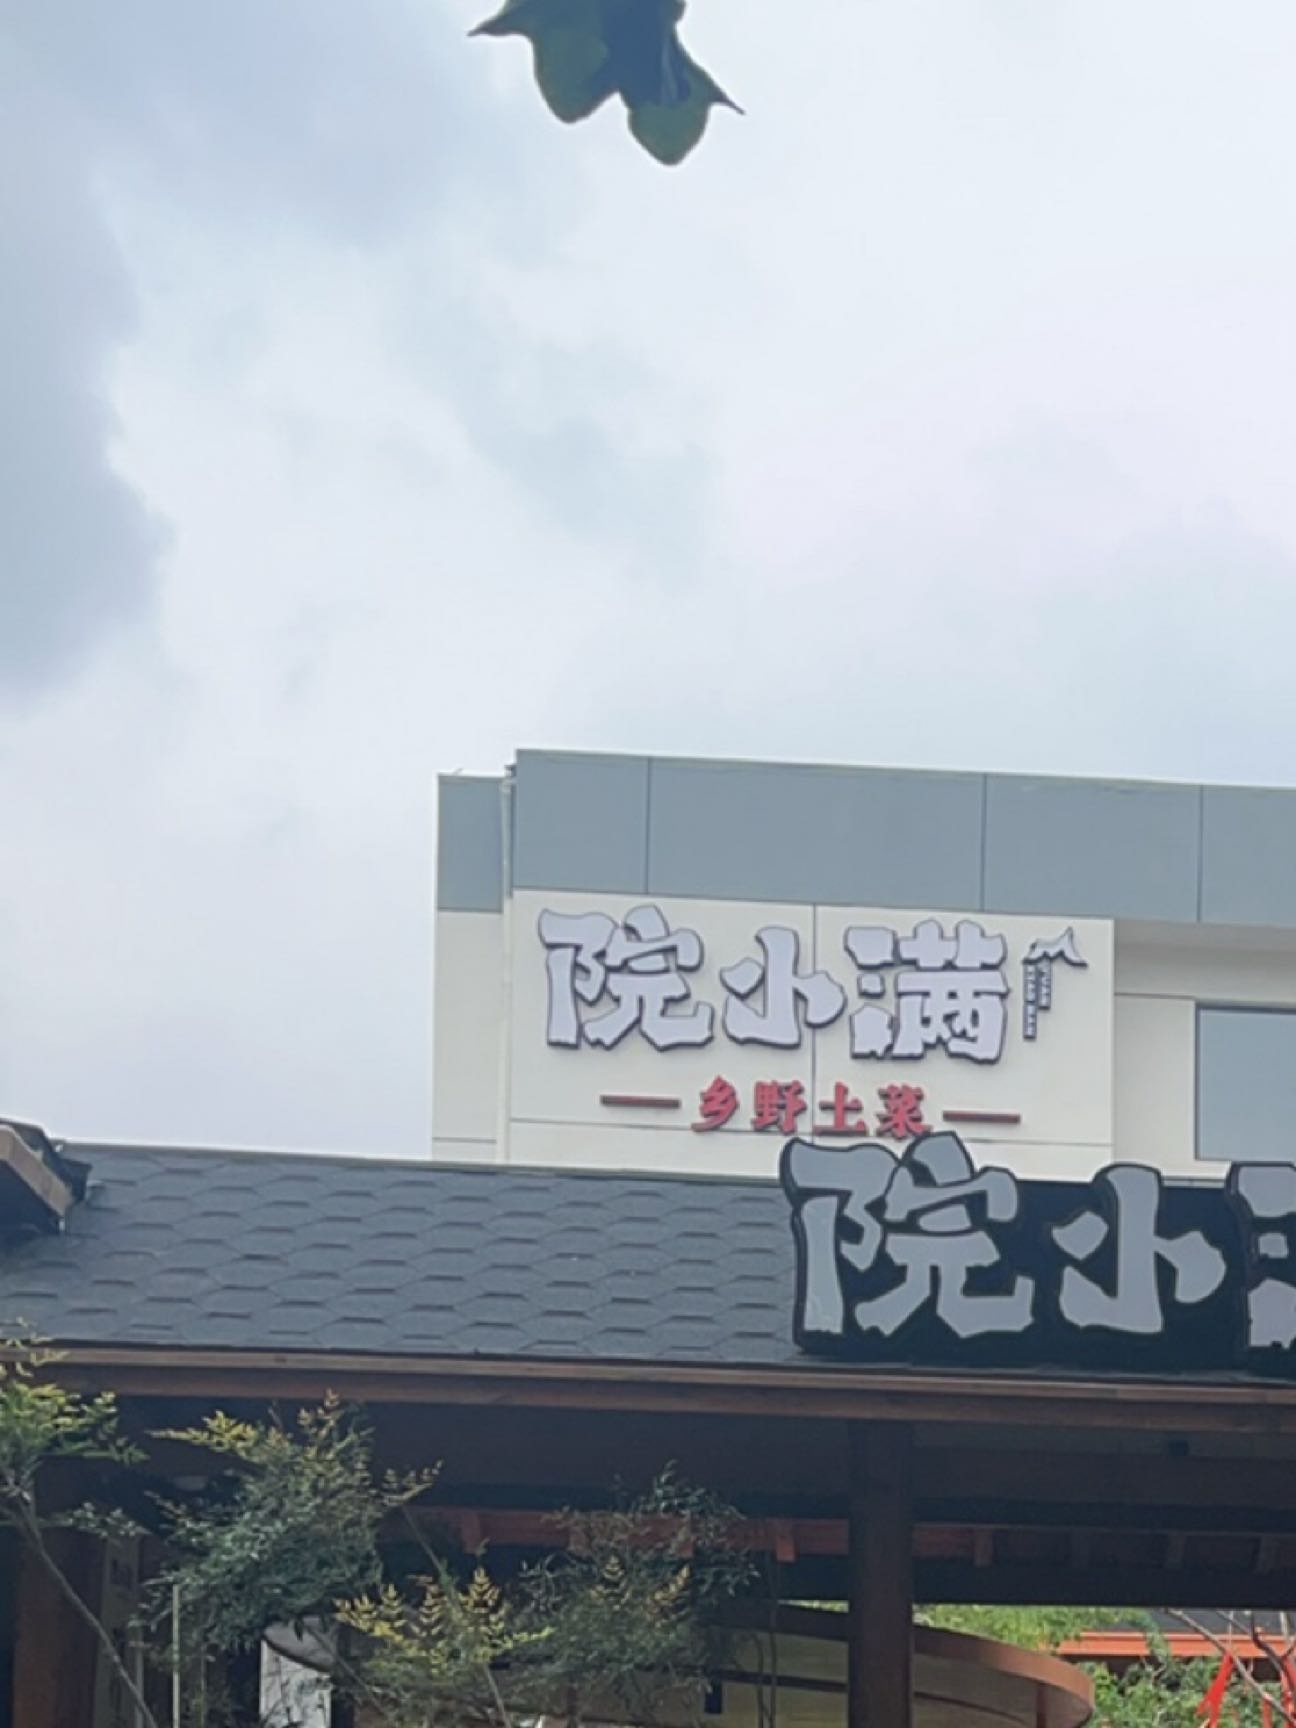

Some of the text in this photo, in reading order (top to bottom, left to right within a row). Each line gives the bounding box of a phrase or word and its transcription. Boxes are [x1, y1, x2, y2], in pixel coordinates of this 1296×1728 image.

[537, 904, 1008, 1064] 院小满
[691, 1077, 932, 1140] 乡野土菜
